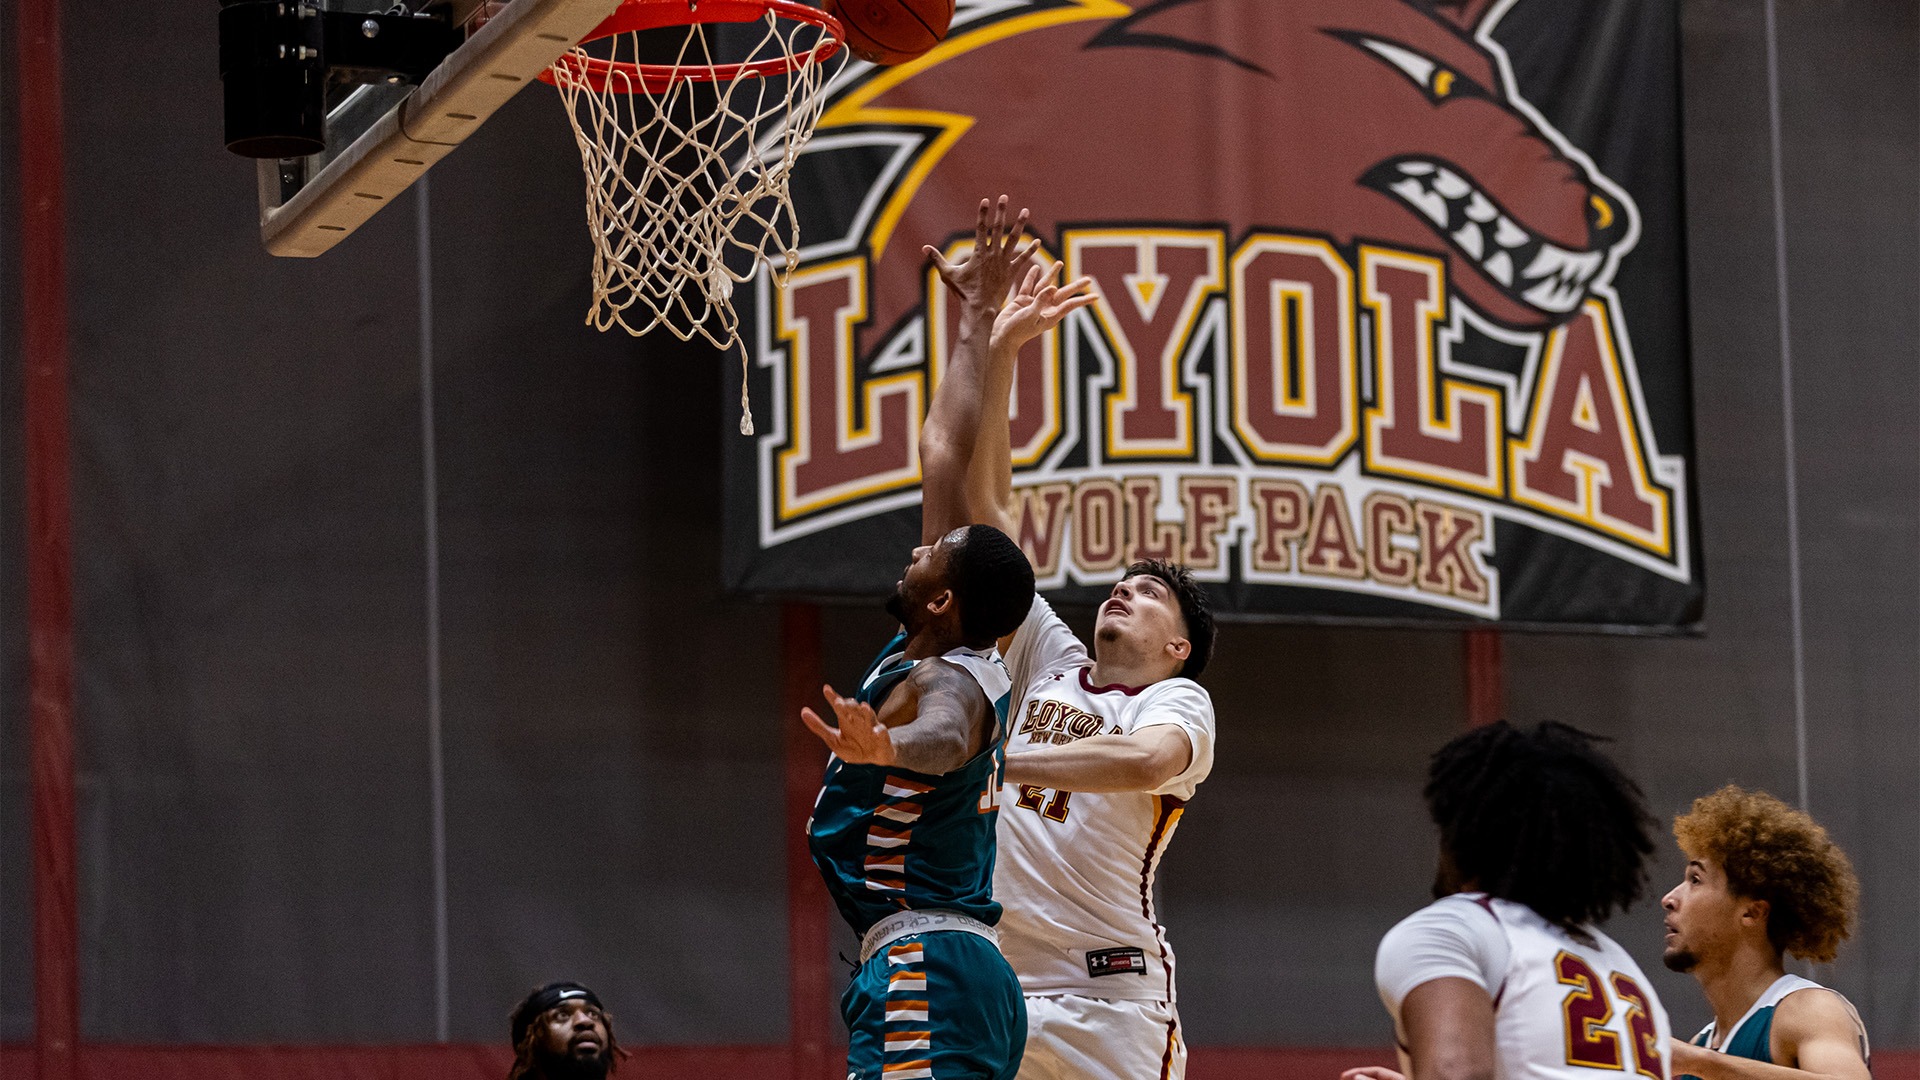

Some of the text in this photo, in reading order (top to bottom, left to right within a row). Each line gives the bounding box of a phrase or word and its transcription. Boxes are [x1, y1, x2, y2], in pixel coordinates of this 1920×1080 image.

[778, 228, 1671, 558] LOYOLA
[1009, 476, 1489, 604] WOLF PACK
[1553, 949, 1665, 1080] 22
